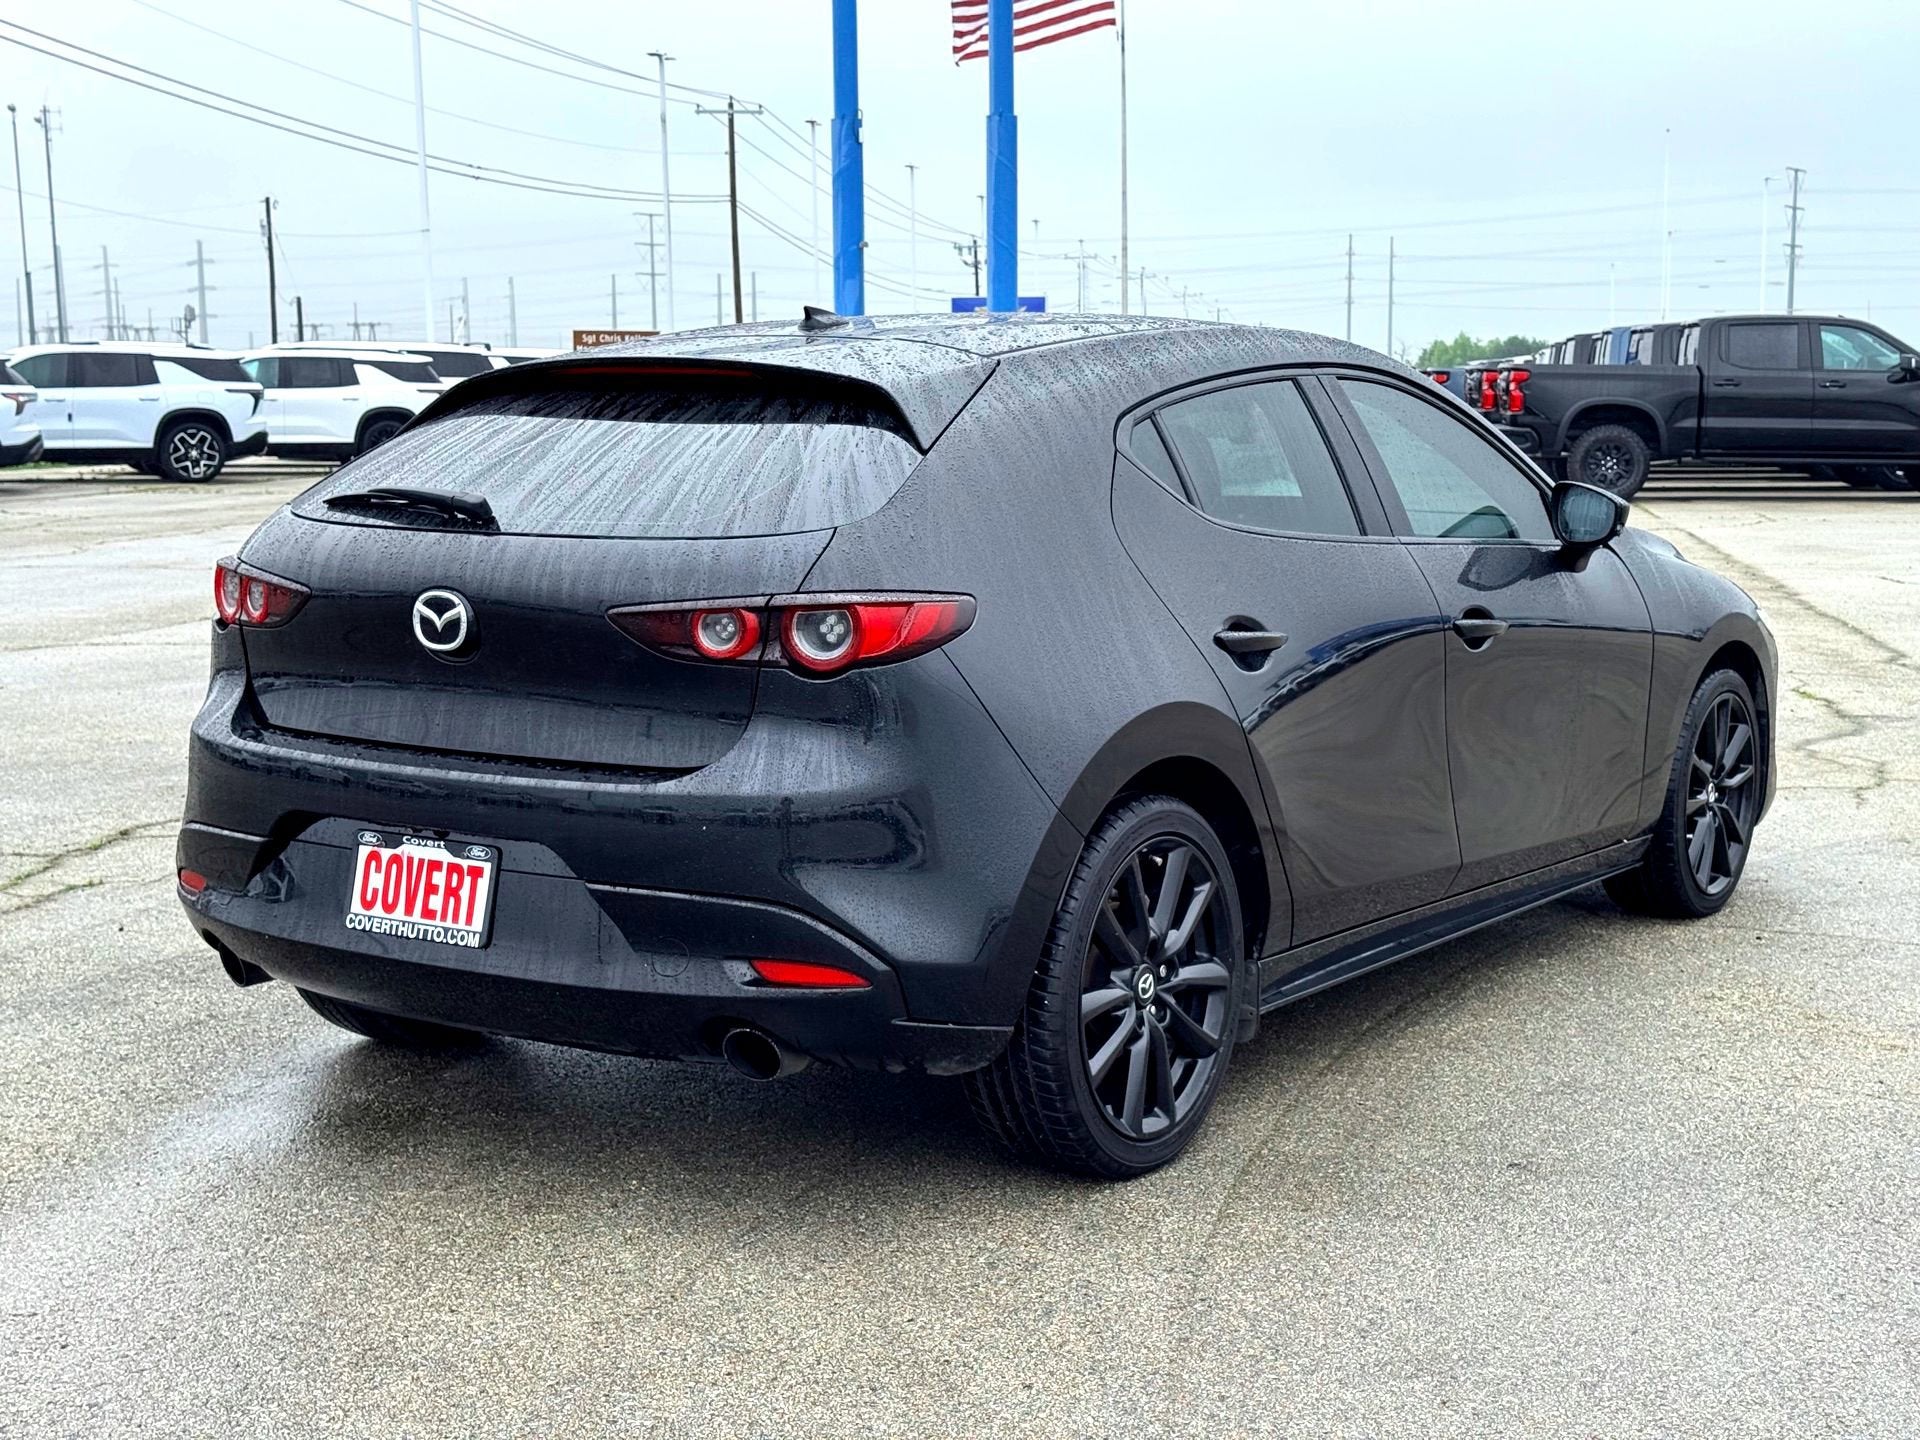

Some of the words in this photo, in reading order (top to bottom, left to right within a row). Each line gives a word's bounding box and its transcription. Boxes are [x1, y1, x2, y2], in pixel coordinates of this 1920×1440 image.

[599, 333, 622, 343] Chris
[361, 832, 379, 844] Ford
[402, 835, 446, 848] Covert
[469, 847, 487, 858] Ford
[360, 850, 484, 926] COVERT
[345, 914, 480, 948] COVERTHUTTO.COM
